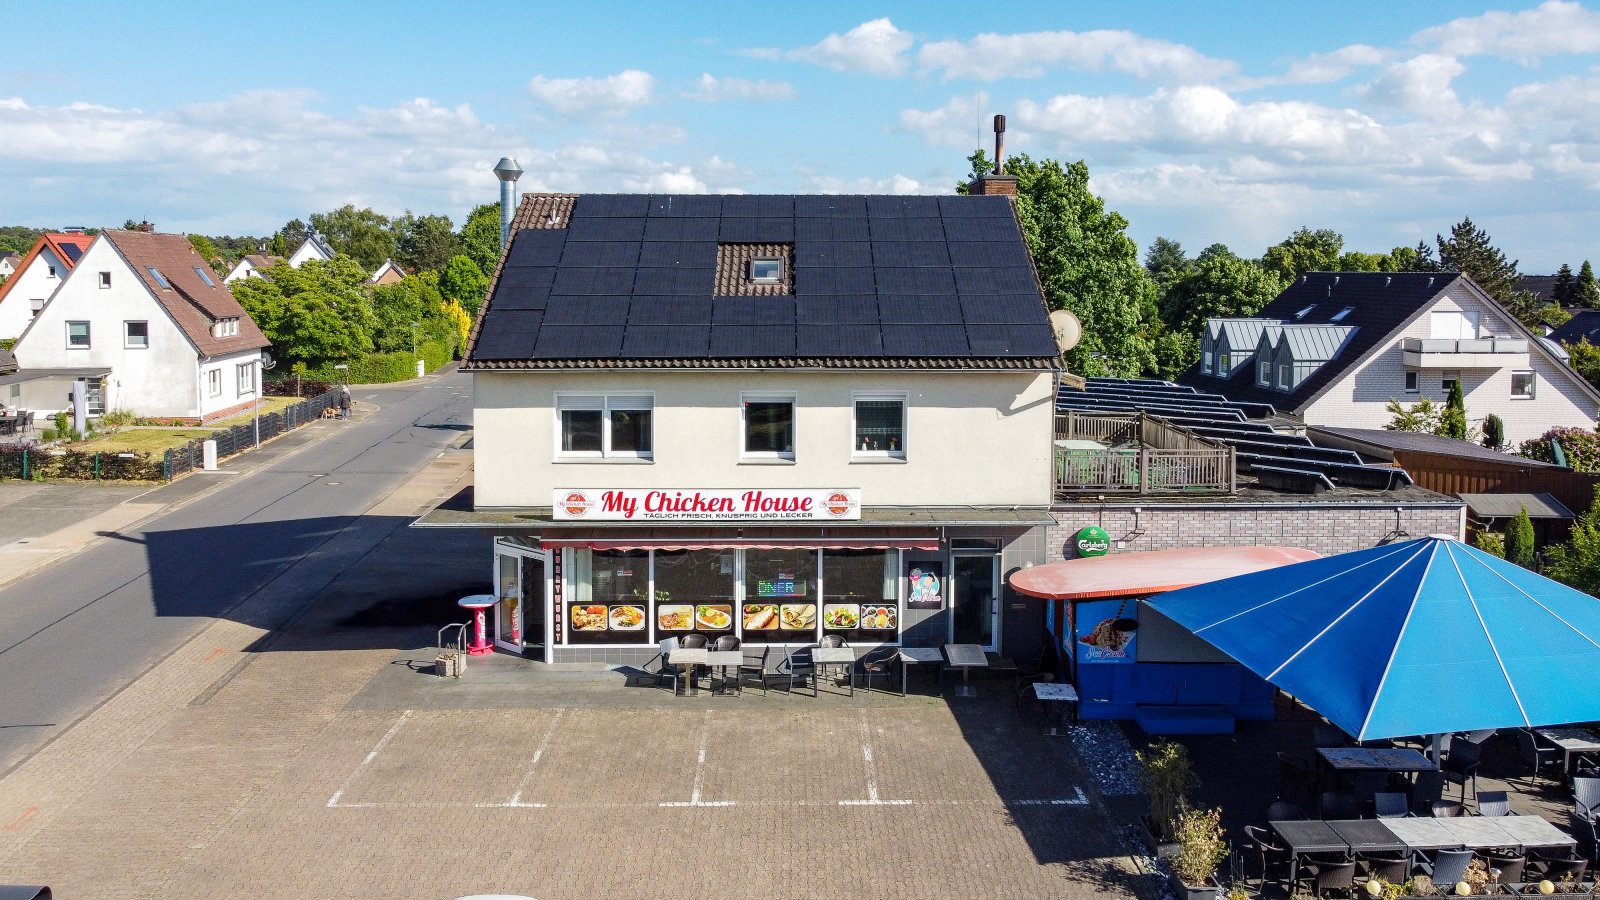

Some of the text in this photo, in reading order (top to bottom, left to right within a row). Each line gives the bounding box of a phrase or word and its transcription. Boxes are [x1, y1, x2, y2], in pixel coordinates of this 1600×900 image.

[601, 490, 814, 519] My Chicken House
[1078, 539, 1108, 552] Carlsberg
